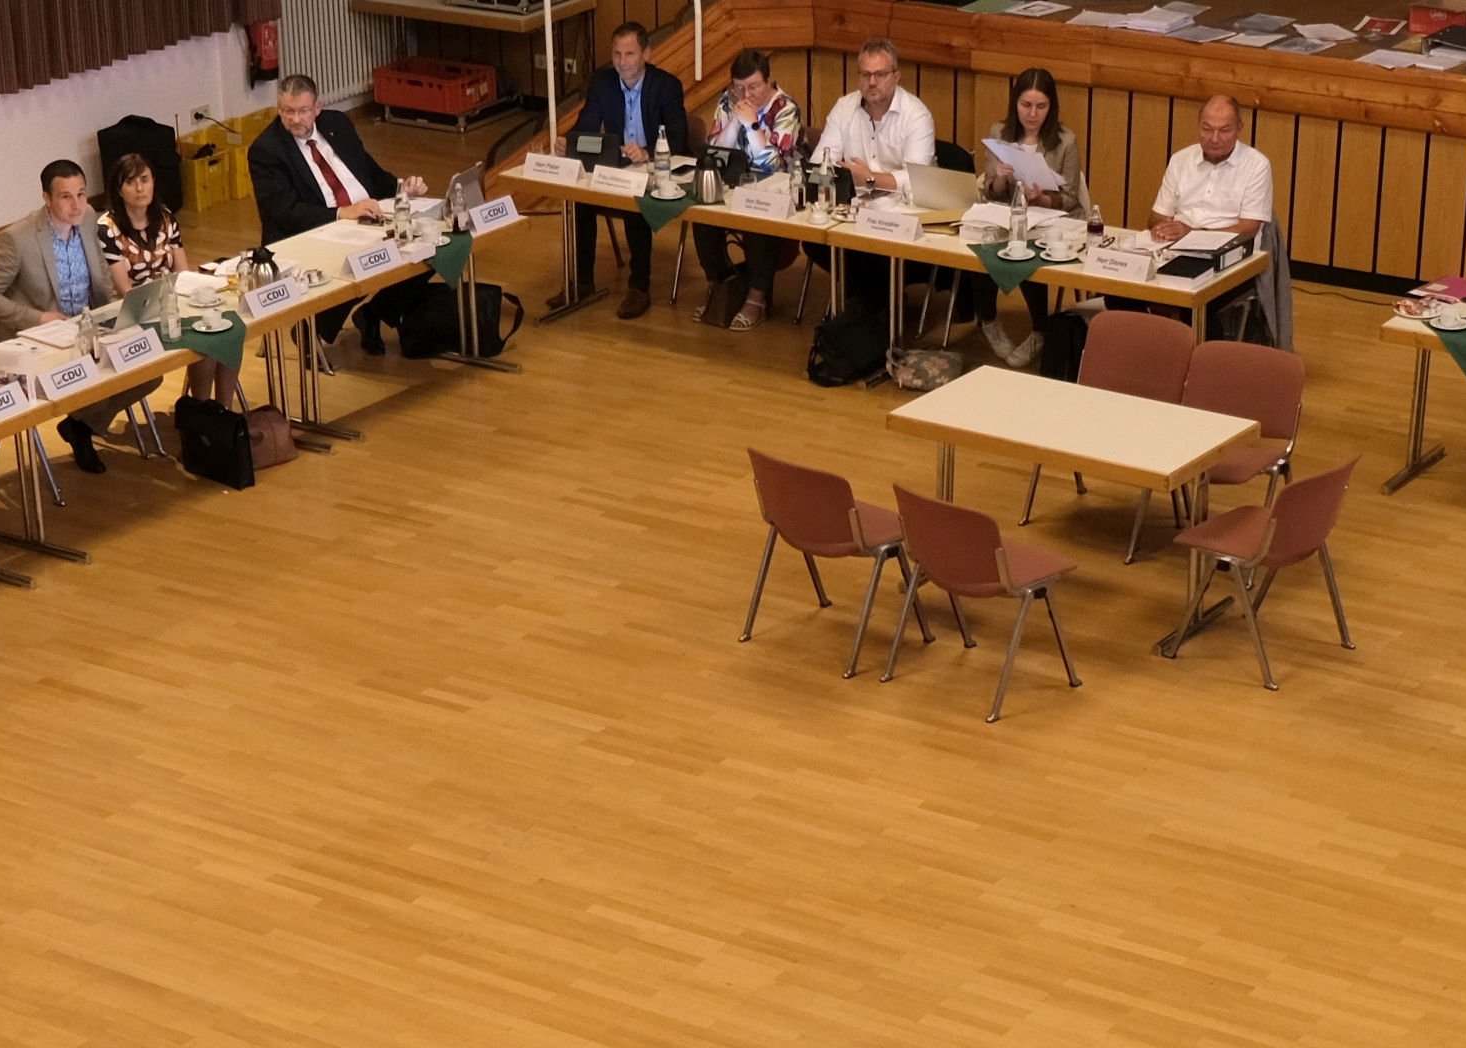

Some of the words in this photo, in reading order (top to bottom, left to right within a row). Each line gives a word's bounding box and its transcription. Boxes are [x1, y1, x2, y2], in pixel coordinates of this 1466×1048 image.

[488, 205, 504, 218] CDU
[368, 252, 386, 265] CDU
[266, 288, 285, 302] CDU
[128, 341, 147, 355] CDU
[62, 369, 82, 383] CDU
